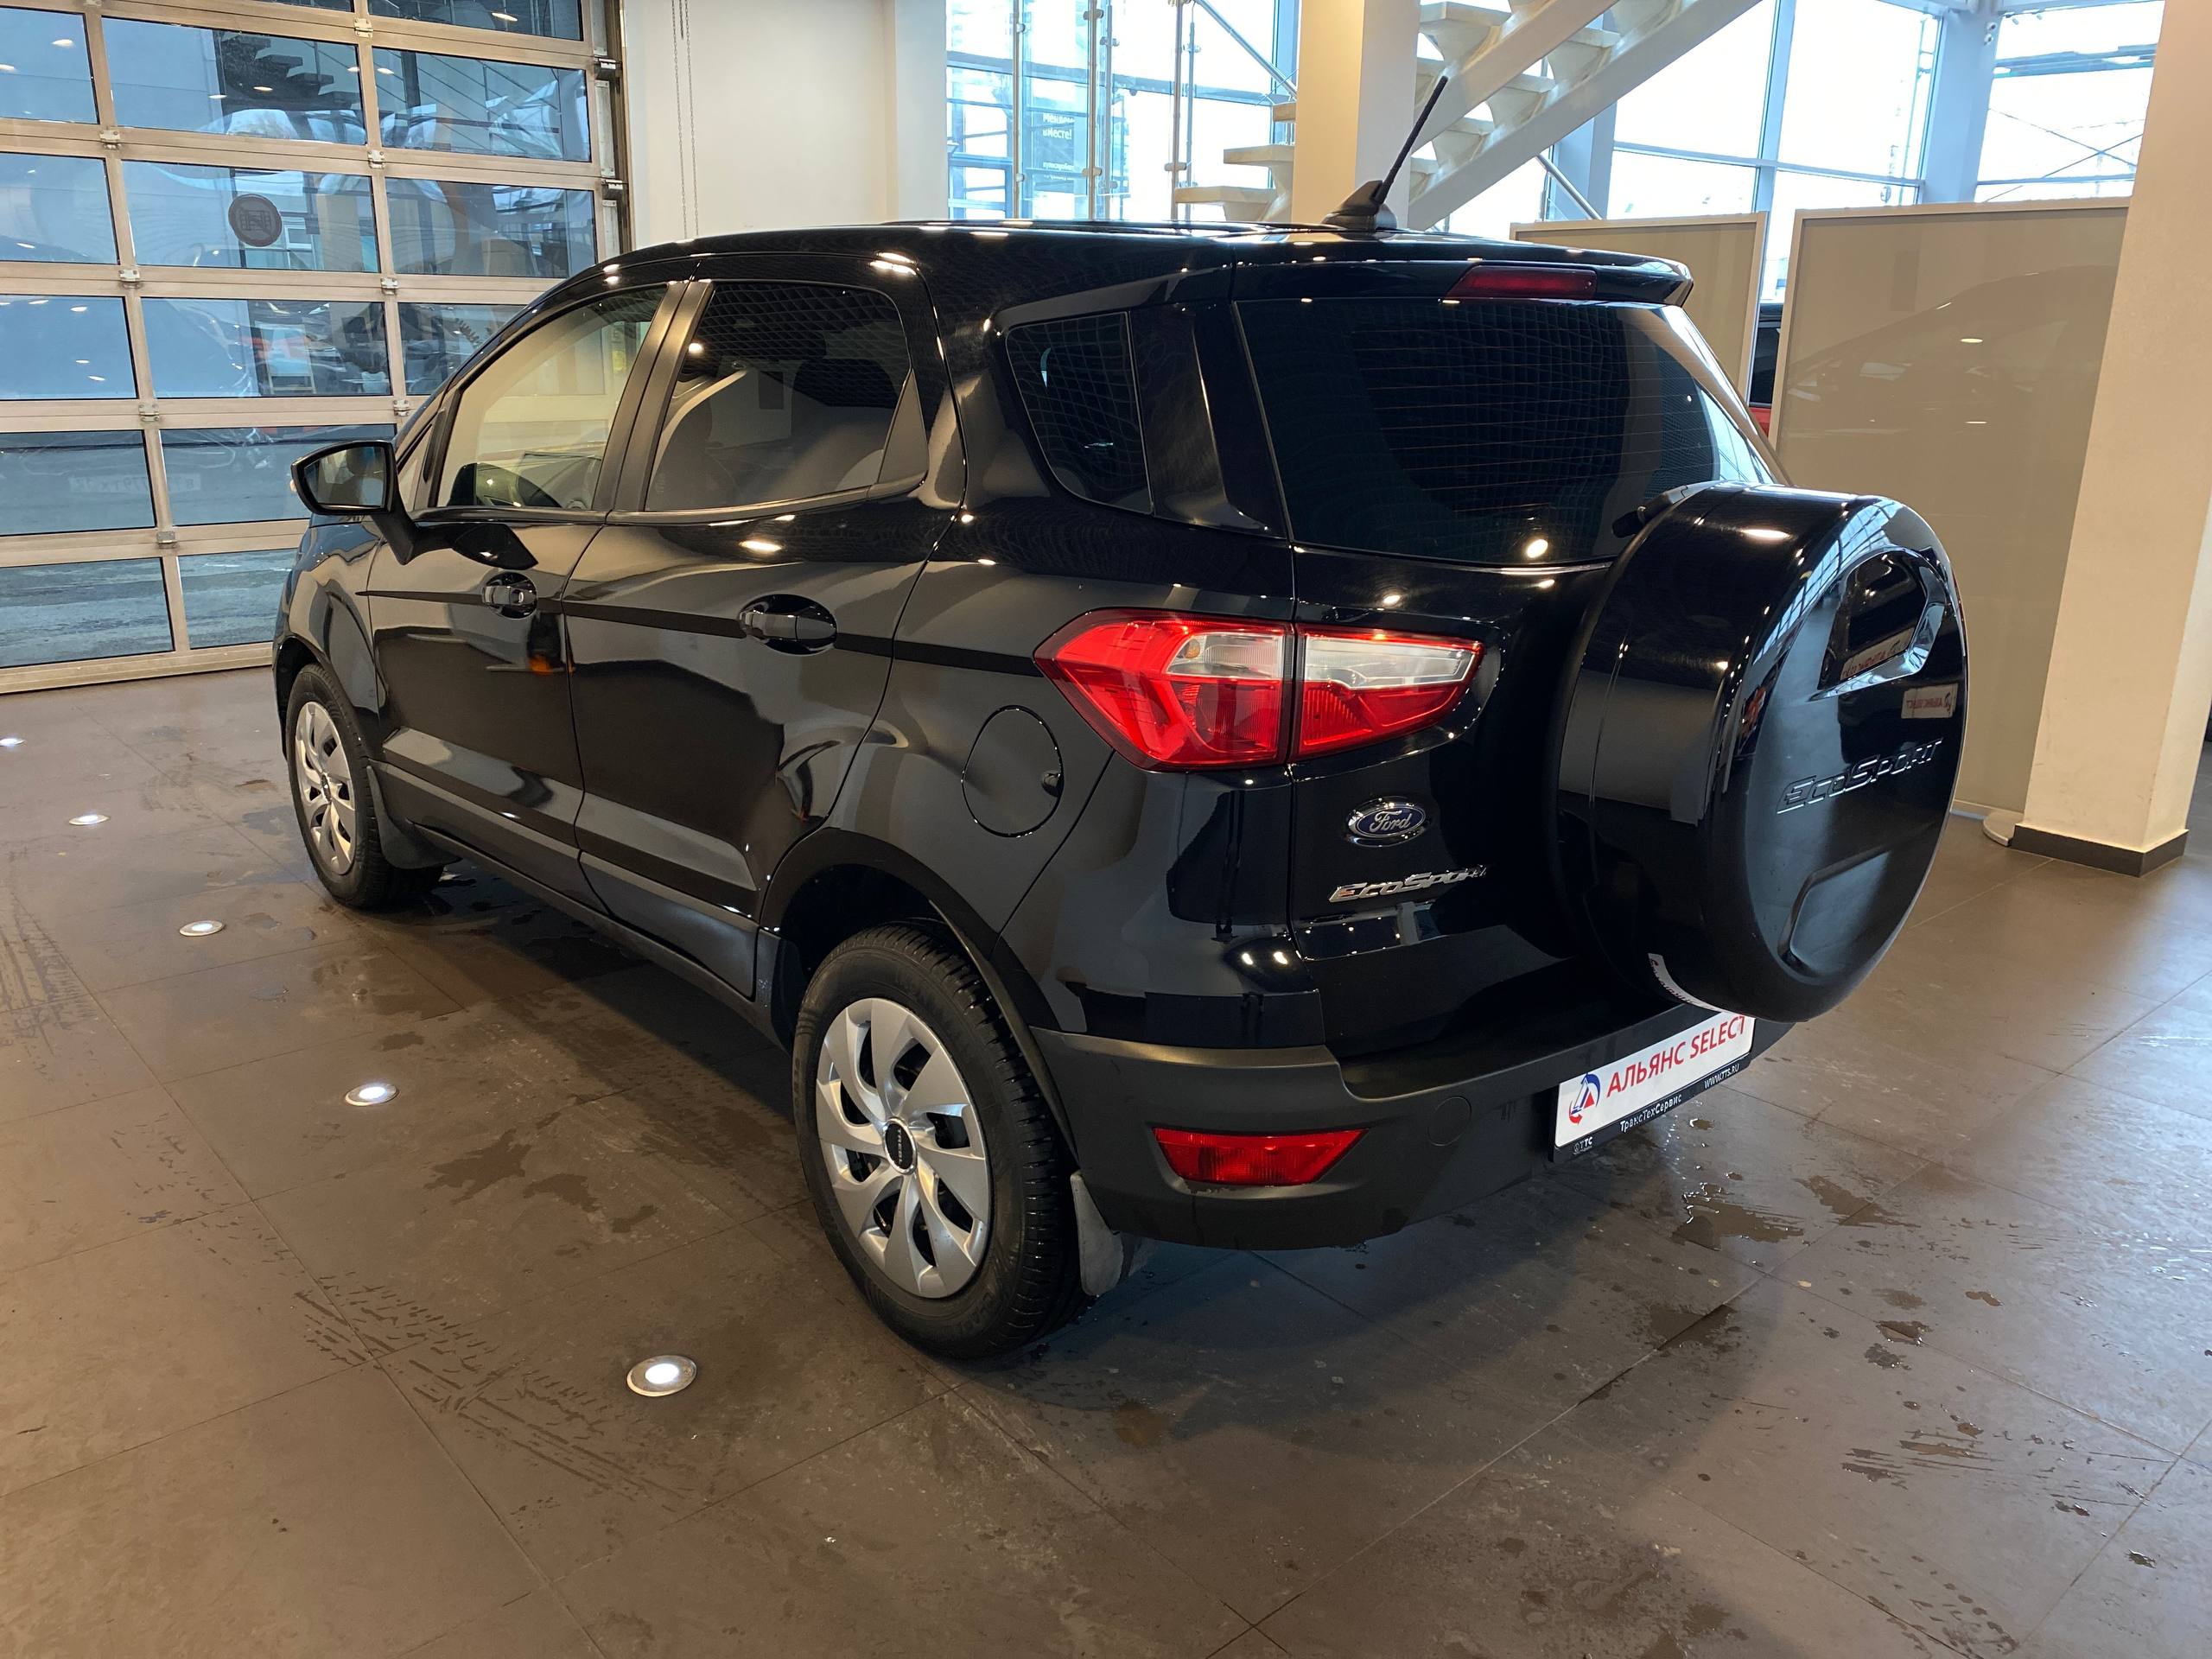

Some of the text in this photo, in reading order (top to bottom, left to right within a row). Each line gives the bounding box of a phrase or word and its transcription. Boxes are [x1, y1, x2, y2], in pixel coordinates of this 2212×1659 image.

[1369, 810, 1413, 833] Ford
[1605, 1014, 1745, 1098] АЛЬЯНС SELECT
[1620, 1095, 1682, 1133] ТрансТехСервис
